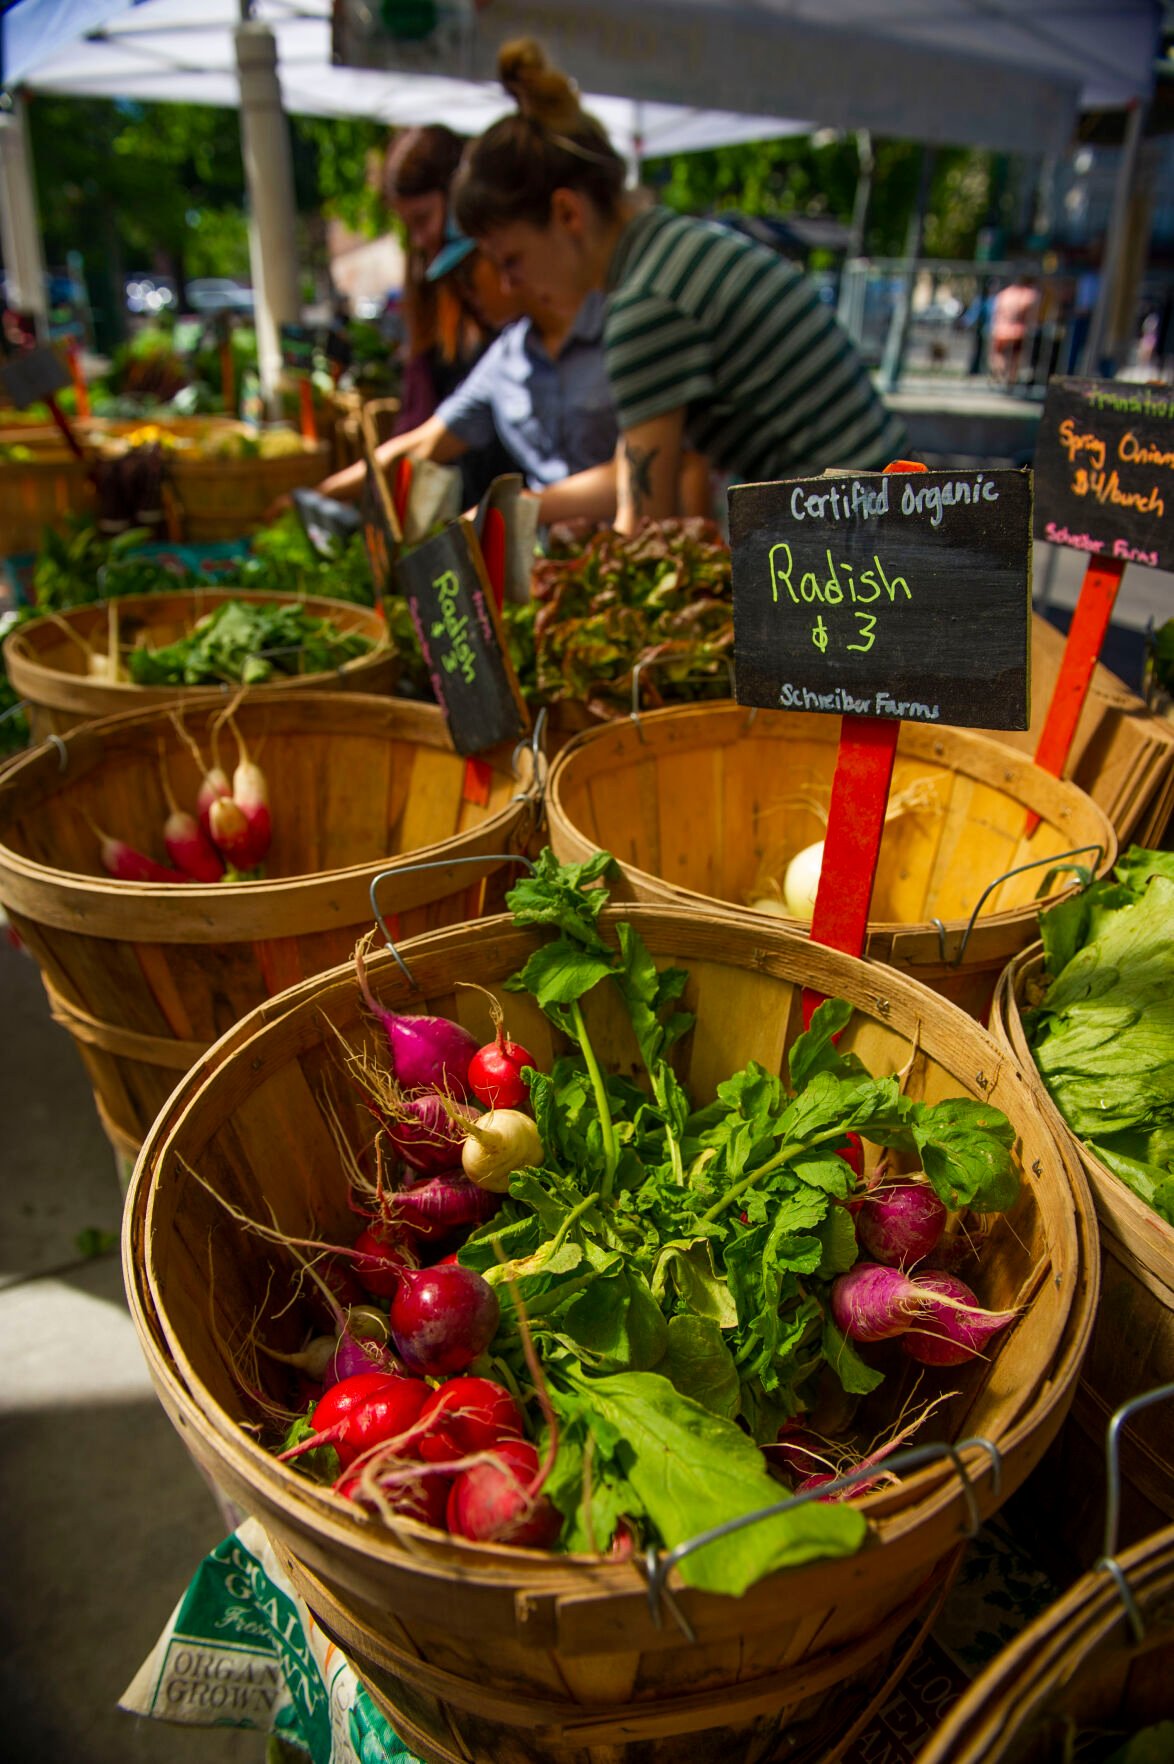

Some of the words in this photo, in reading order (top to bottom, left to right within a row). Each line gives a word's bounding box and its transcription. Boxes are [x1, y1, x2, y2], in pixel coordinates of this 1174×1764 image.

[791, 476, 889, 521] Certified
[769, 543, 912, 604] Radish
[432, 569, 477, 685] Radish
[812, 615, 829, 653] $
[847, 611, 877, 652] 3
[780, 683, 871, 714] Schreiber
[876, 692, 940, 719] Farms
[175, 1650, 279, 1685] ORGAN
[166, 1679, 279, 1713] GROWN
